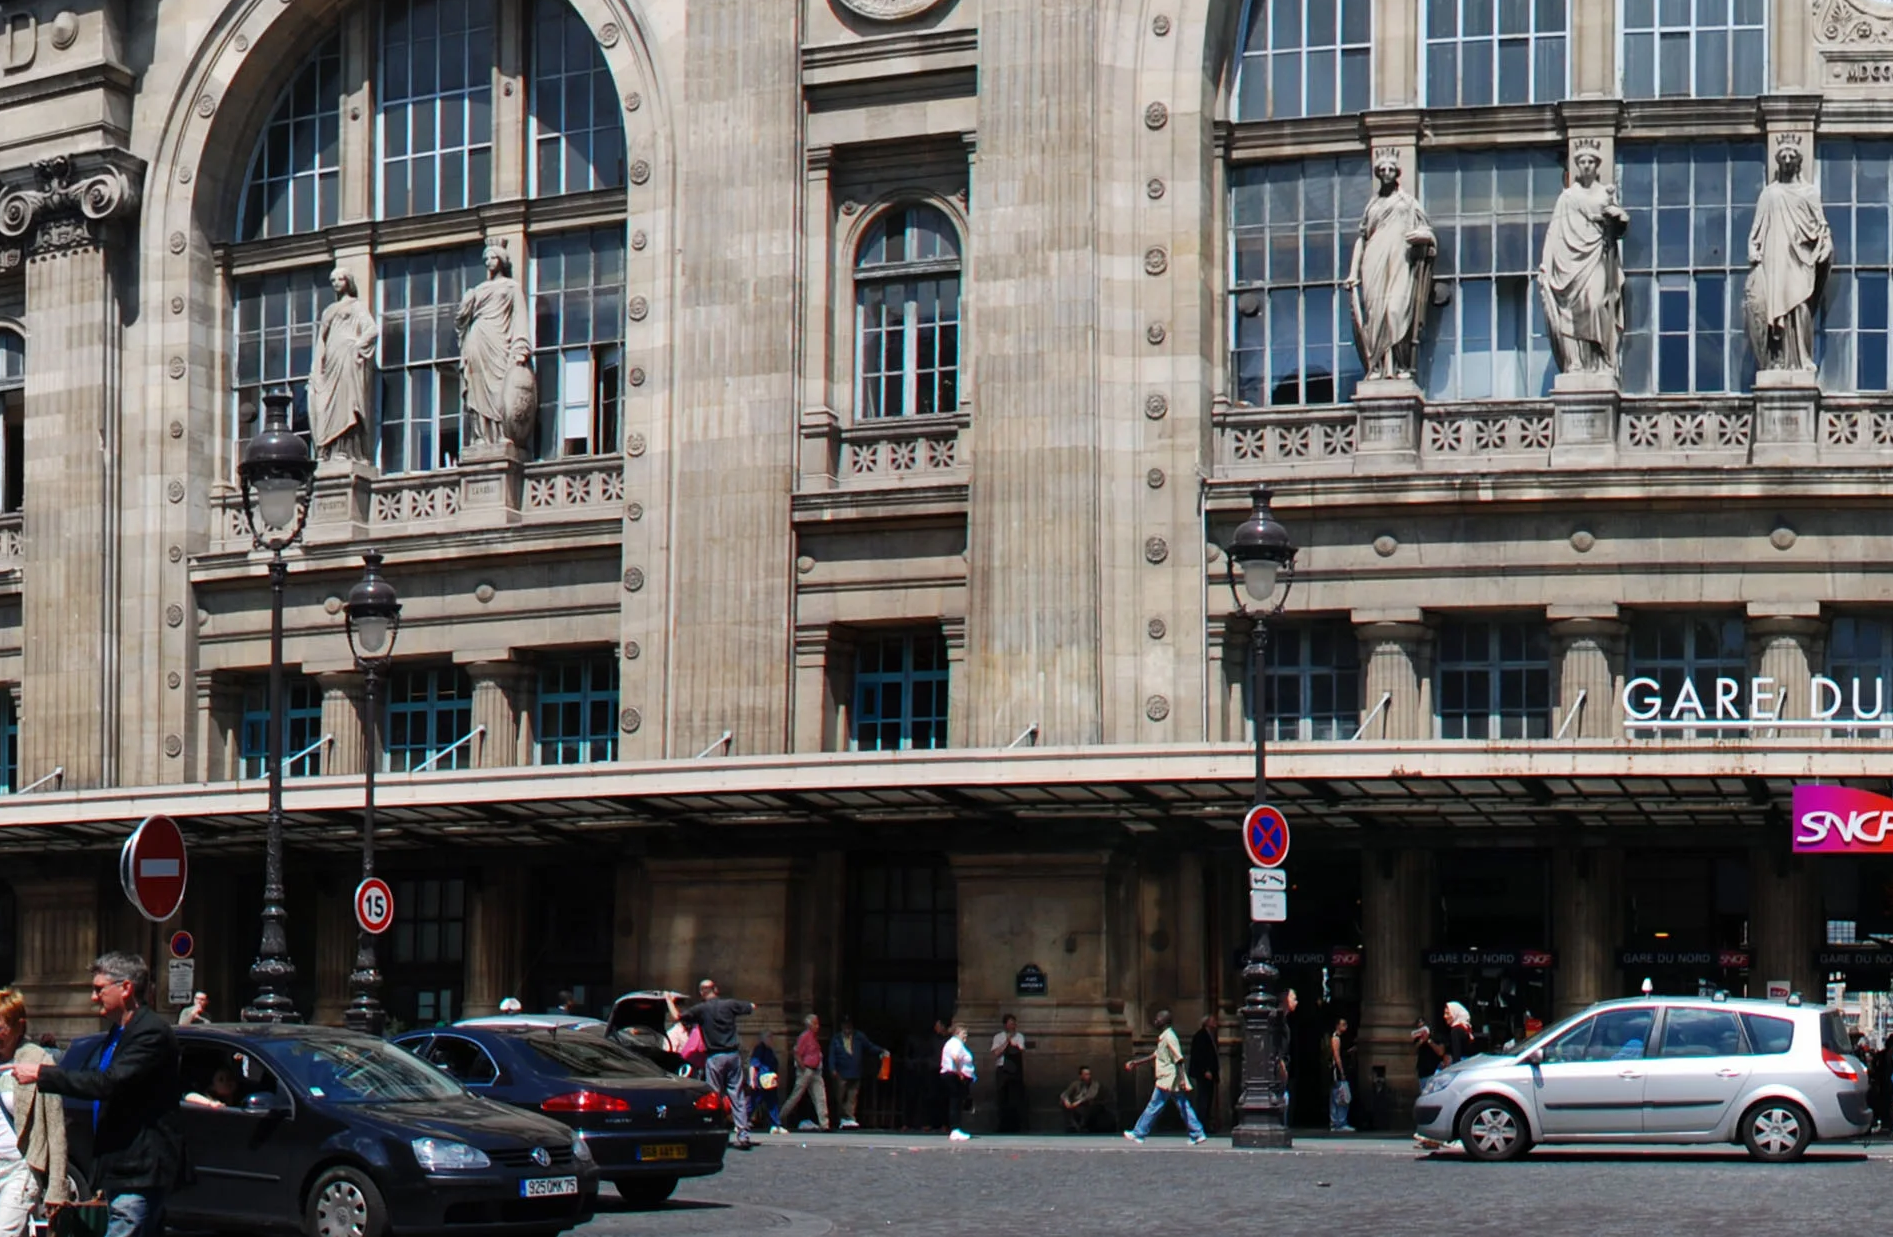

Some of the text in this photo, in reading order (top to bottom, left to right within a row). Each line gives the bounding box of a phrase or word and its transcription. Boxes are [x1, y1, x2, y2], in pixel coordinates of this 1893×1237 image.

[1623, 677, 1775, 719] GARE
[1811, 677, 1882, 719] DU
[366, 895, 384, 917] 15
[1429, 953, 1515, 964] GARE DU NORD
[1522, 954, 1552, 965] SNCF
[1623, 953, 1711, 964] GARE DU NORD
[1719, 953, 1748, 965] SNCF
[1820, 953, 1850, 964] GARE
[1855, 953, 1871, 964] DU
[529, 1180, 546, 1194] 925
[564, 1178, 576, 1192] 75
